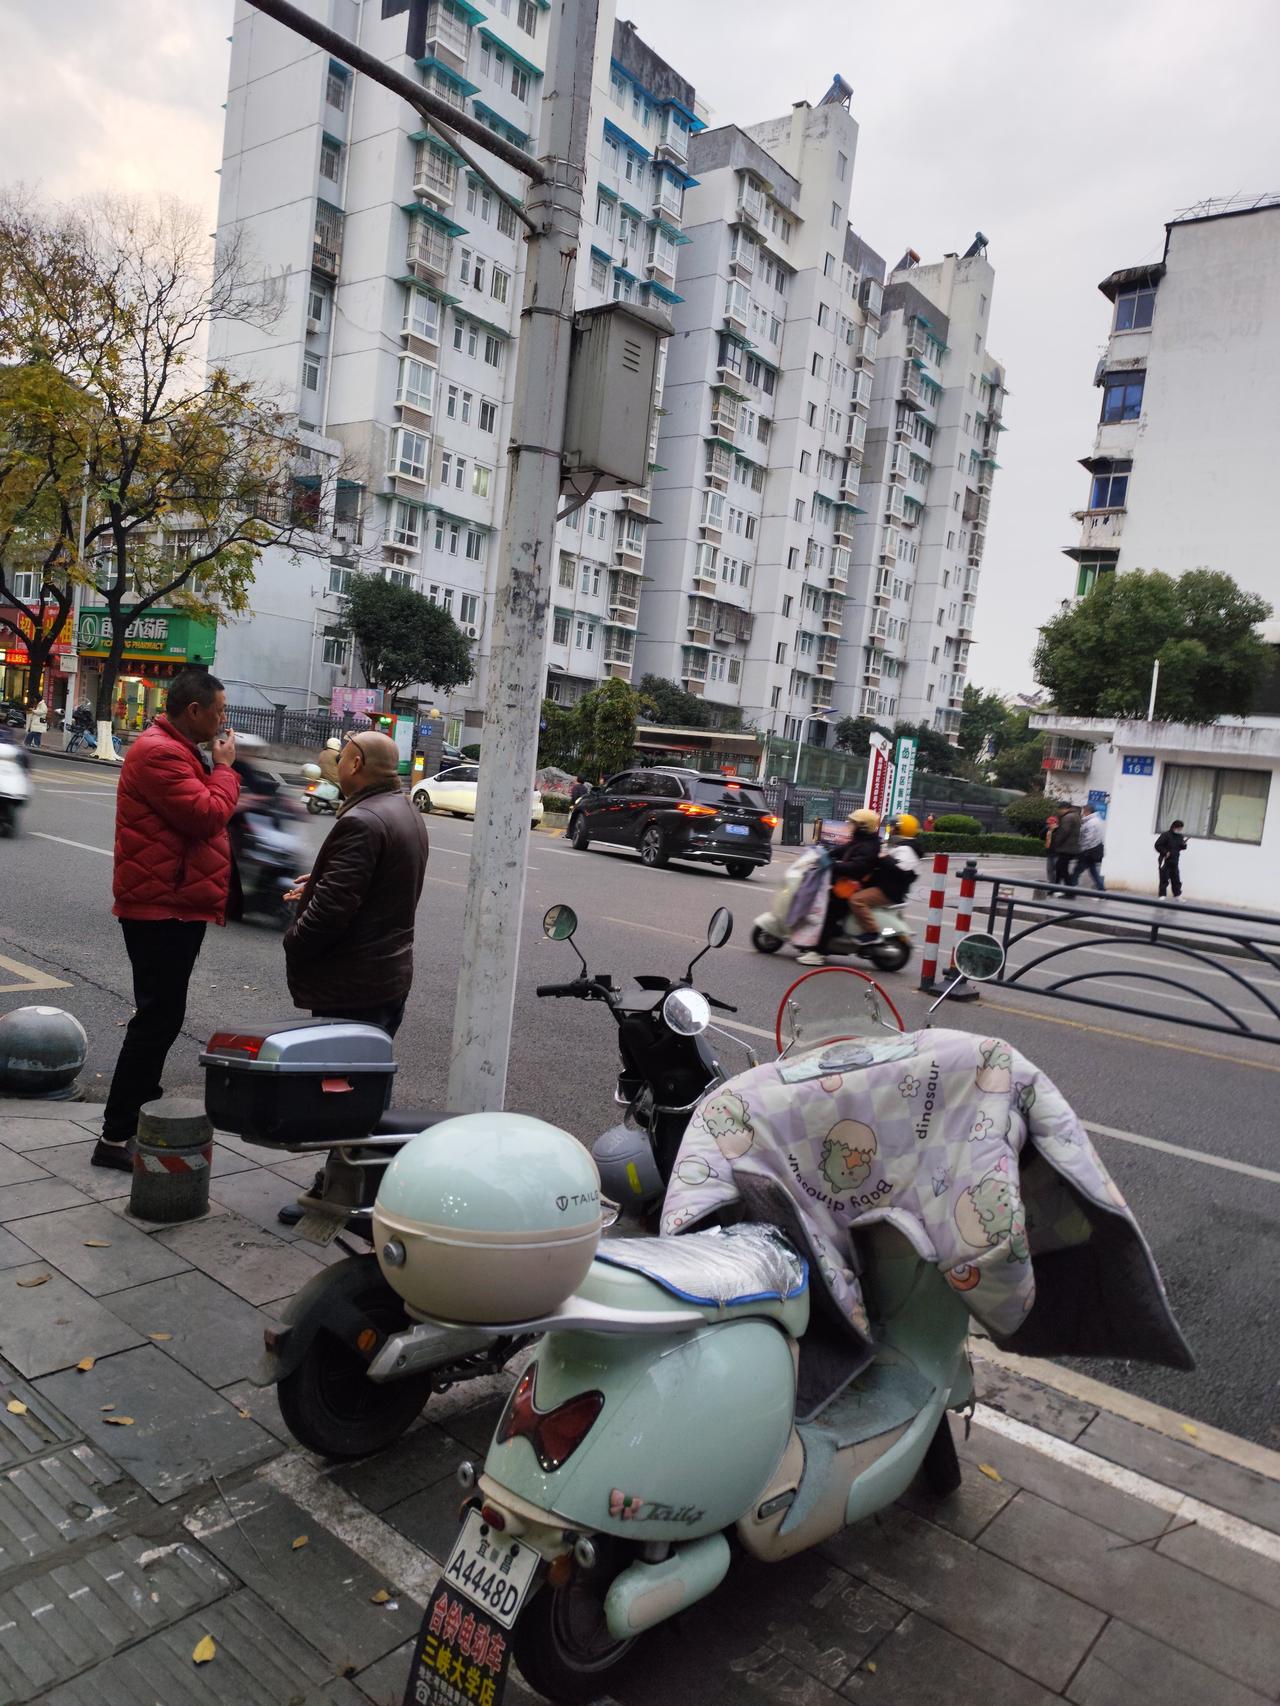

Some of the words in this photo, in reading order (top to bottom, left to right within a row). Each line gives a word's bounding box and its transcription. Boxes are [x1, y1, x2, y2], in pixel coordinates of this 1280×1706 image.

[916, 1060, 940, 1139] dinosaur
[788, 1154, 845, 1211] dinosaur
[850, 1179, 893, 1208] Baby
[448, 1549, 519, 1617] A4448D
[429, 1592, 507, 1676] 台铃电动车
[421, 1635, 497, 1706] 三峡大学店
